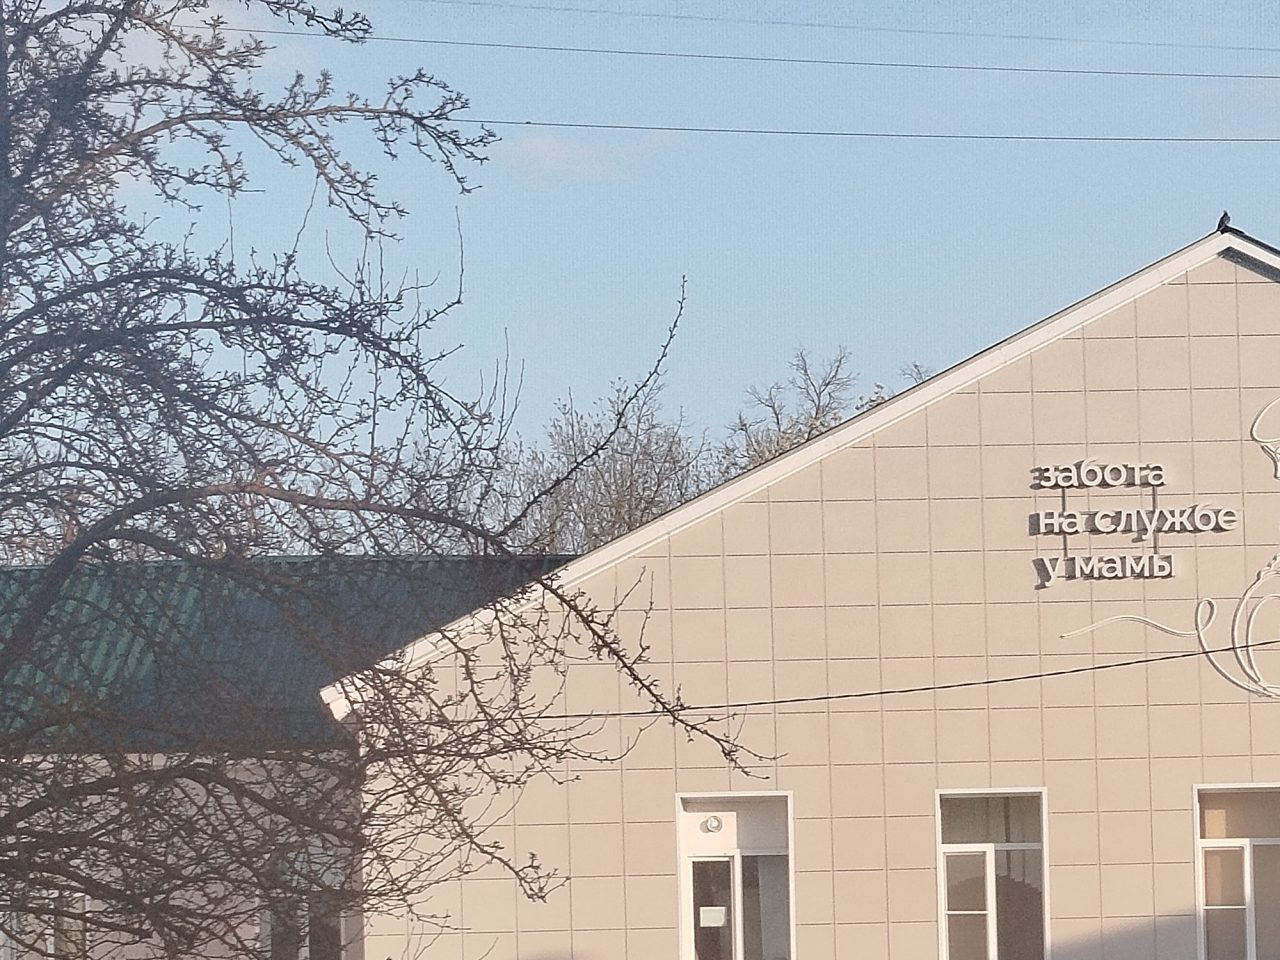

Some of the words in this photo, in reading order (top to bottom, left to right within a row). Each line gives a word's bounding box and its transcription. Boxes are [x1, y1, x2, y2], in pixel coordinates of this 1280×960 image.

[1039, 459, 1166, 487] забота
[1037, 509, 1084, 534] на
[1094, 504, 1241, 540] службе
[1041, 555, 1062, 587] у
[1074, 553, 1176, 579] мамы
